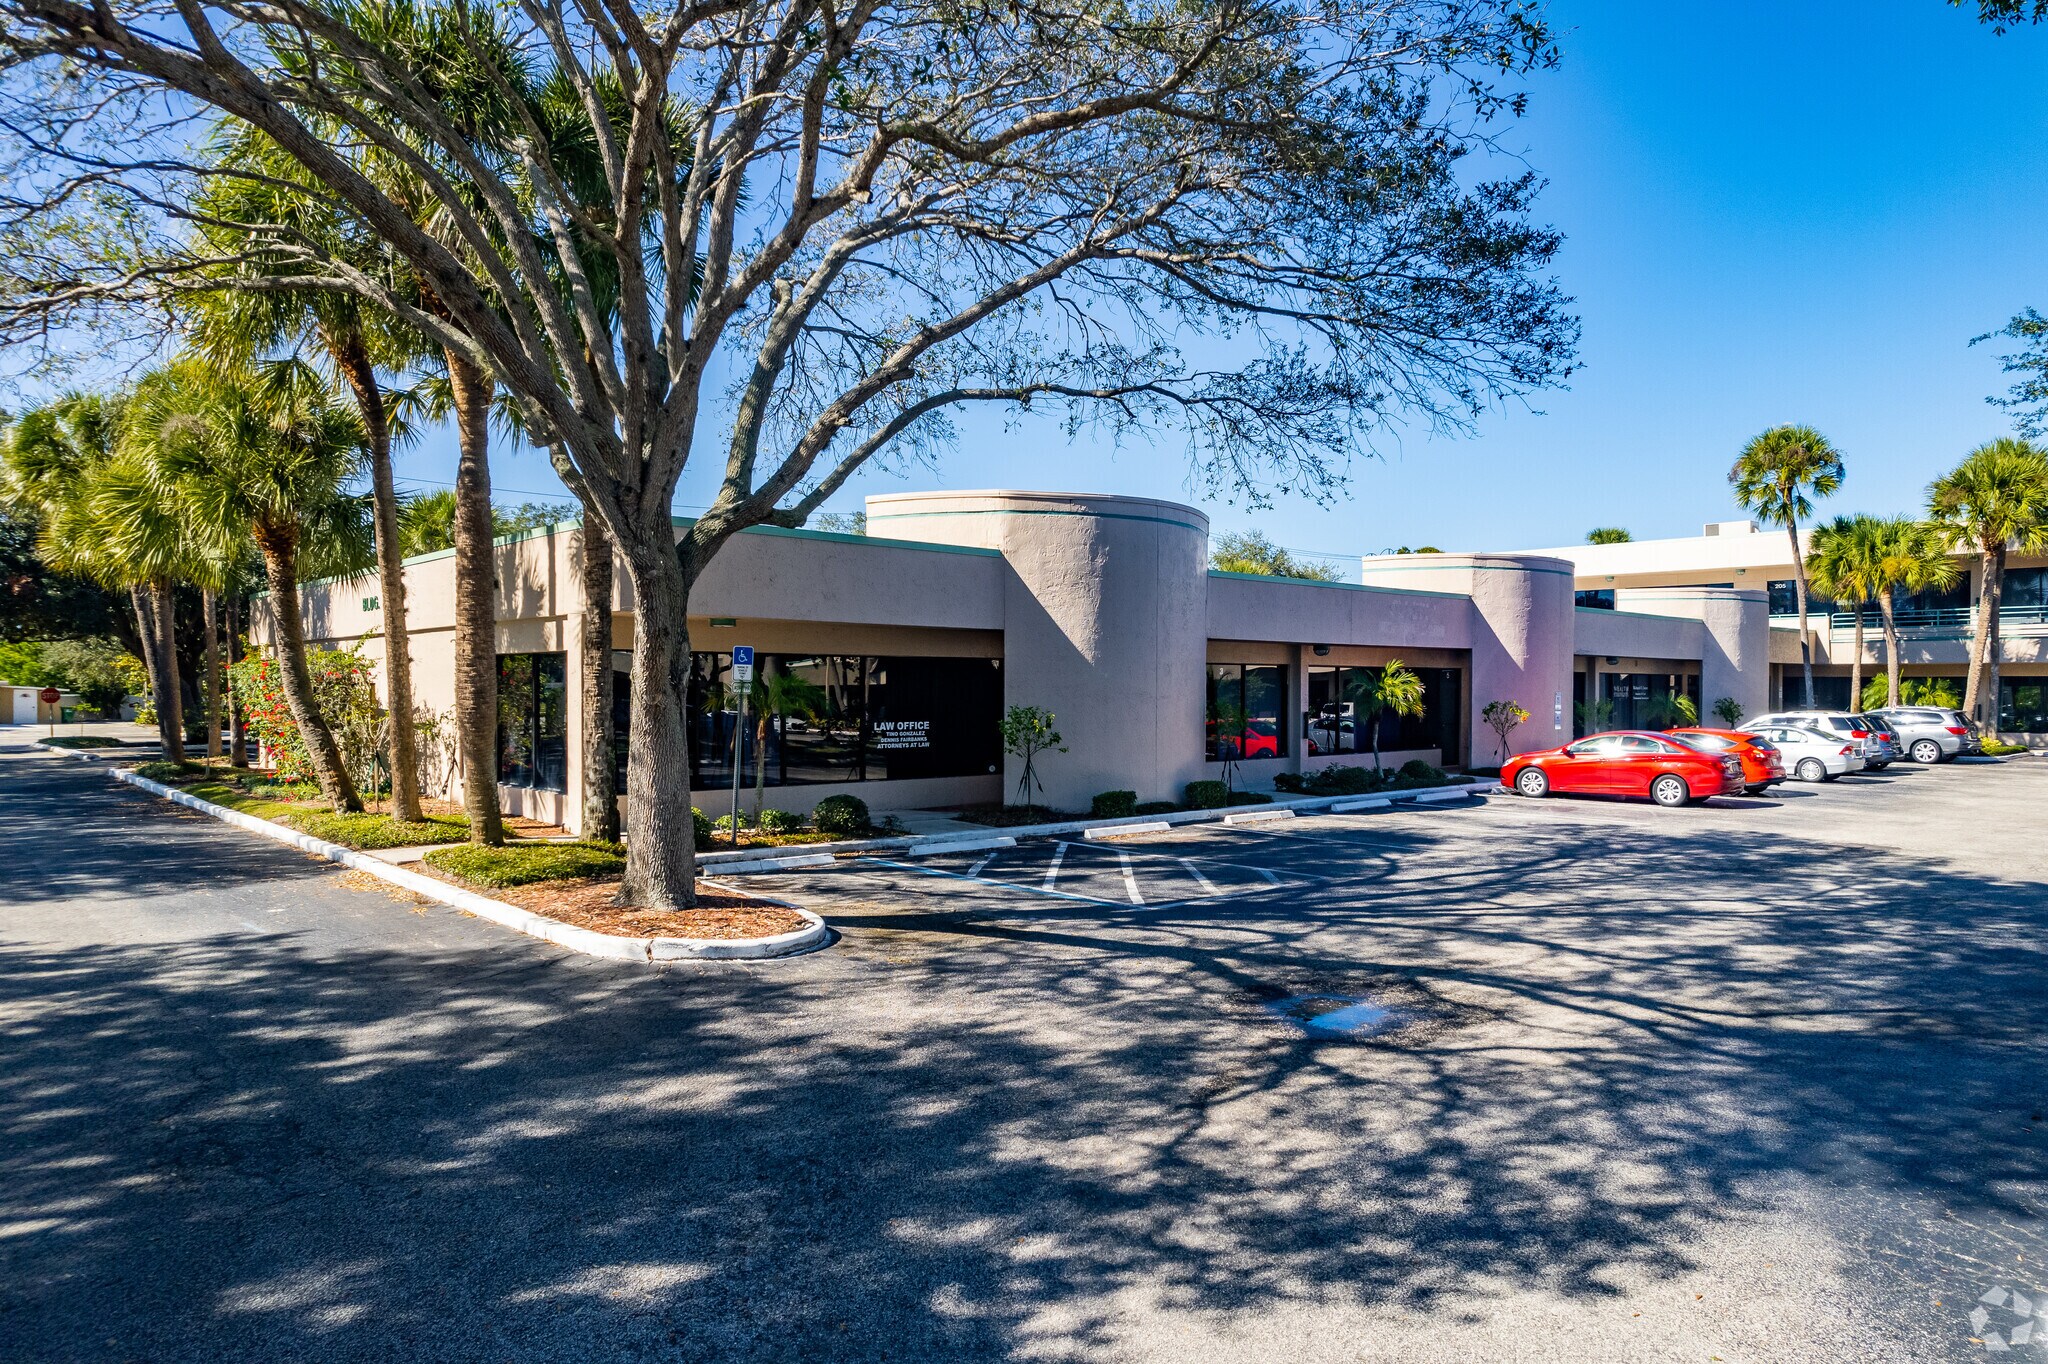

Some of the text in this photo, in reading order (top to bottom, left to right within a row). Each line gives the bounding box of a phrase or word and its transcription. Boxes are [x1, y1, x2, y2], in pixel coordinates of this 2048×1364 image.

[363, 596, 380, 612] BLDG.
[874, 721, 930, 731] LAW OFFICE
